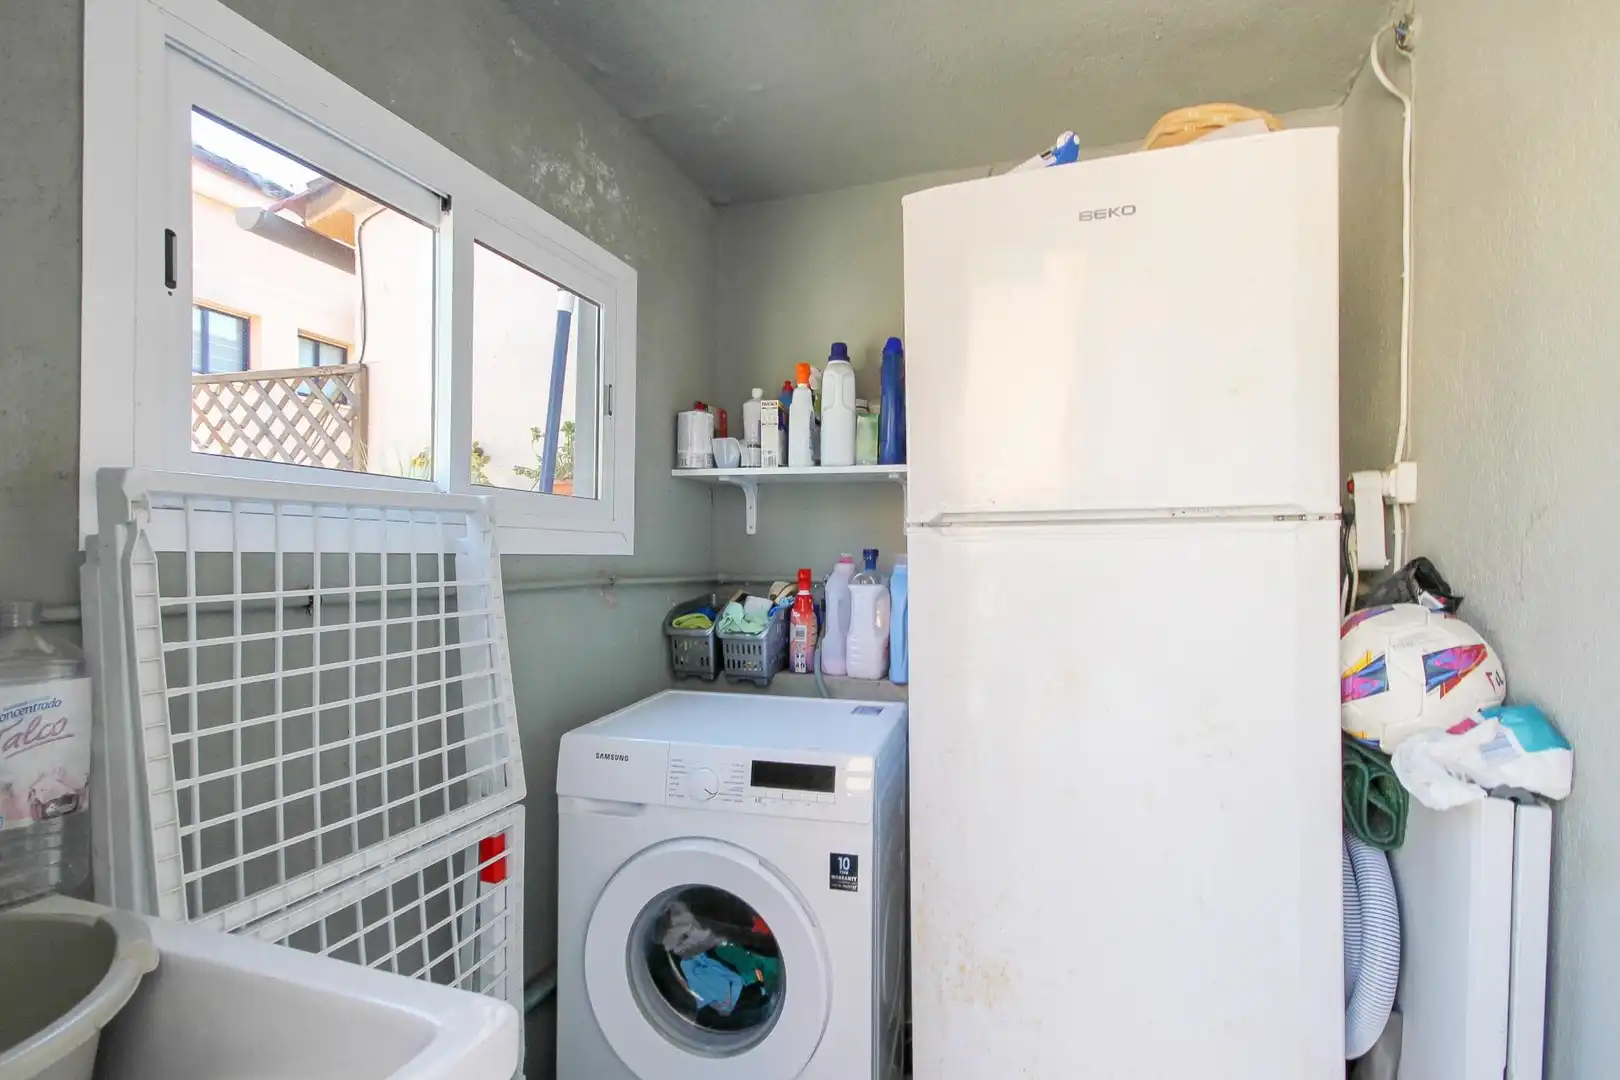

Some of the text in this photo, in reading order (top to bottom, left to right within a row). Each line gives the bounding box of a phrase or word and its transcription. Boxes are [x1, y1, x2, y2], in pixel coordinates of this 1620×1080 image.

[1079, 204, 1136, 221] BEKO
[595, 752, 629, 762] SAMSUNG
[838, 856, 851, 871] 10
